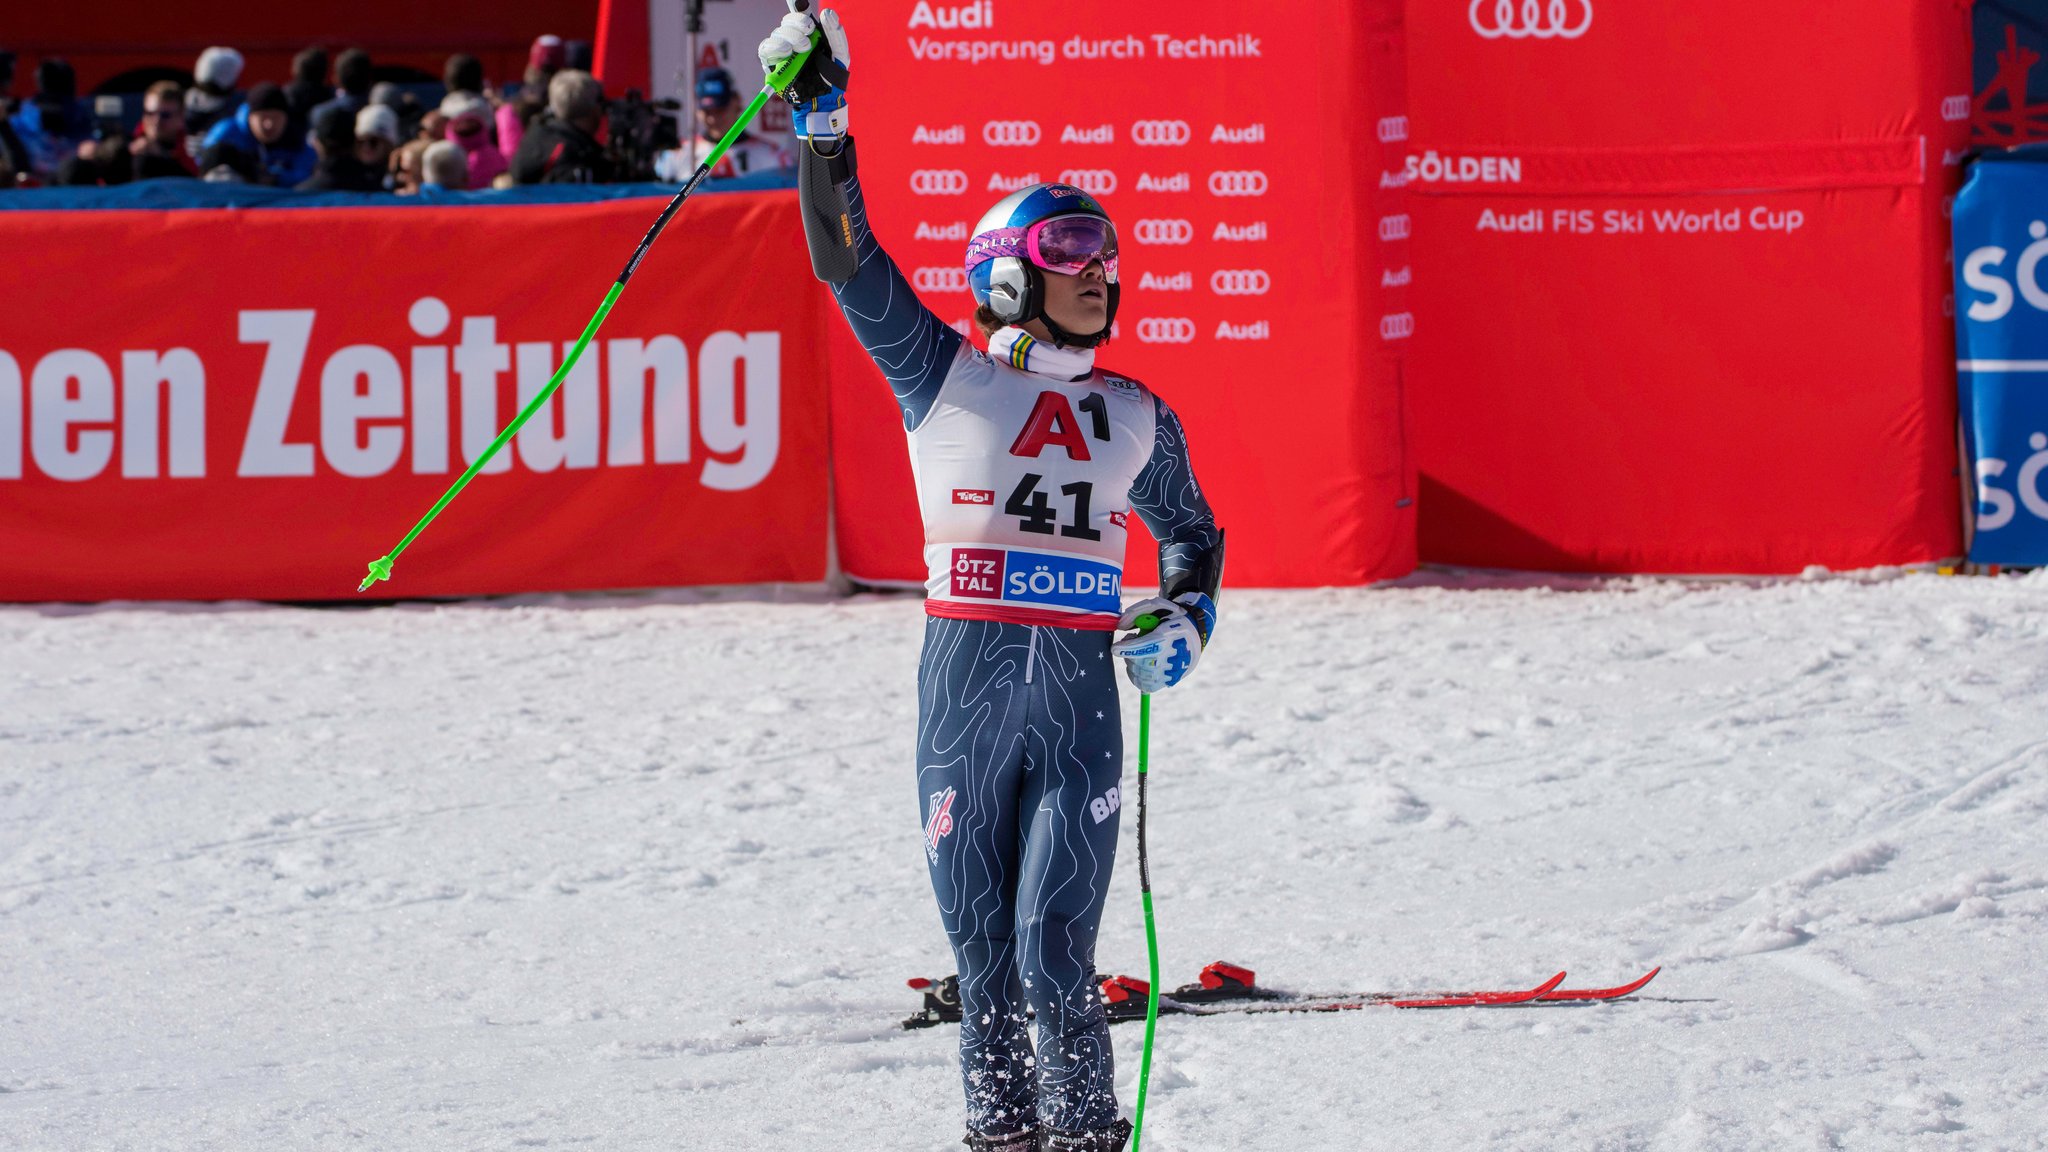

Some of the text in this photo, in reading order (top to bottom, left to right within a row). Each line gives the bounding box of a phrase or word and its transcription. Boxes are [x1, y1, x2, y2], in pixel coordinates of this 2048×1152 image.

[908, 0, 993, 29] Audi
[908, 34, 1261, 65] Vorsprung durch Technik
[912, 125, 965, 145] Audi
[1060, 124, 1114, 144] Audi
[1210, 124, 1265, 143] Audi
[1406, 151, 1521, 182] SÖLDEN
[987, 172, 1041, 192] Audi
[1136, 172, 1190, 192] Audi
[1476, 206, 1804, 234] Audi FIS Ski World Cup
[914, 221, 968, 241] Audi
[1212, 222, 1267, 241] Audi
[968, 237, 1021, 259] OAKLEY
[1138, 271, 1193, 291] Audi
[1215, 321, 1270, 340] Audi
[0, 297, 782, 492] en Zeitung
[1008, 390, 1111, 462] A1
[957, 491, 990, 503] Tirol
[1004, 472, 1102, 542] 41
[955, 553, 997, 575] ÖTZ
[955, 576, 994, 592] TAL
[1009, 565, 1122, 597] SÖLDEN
[1119, 642, 1160, 656] reusch
[1089, 777, 1122, 825] BR
[1050, 1134, 1088, 1145] ATOMIC
